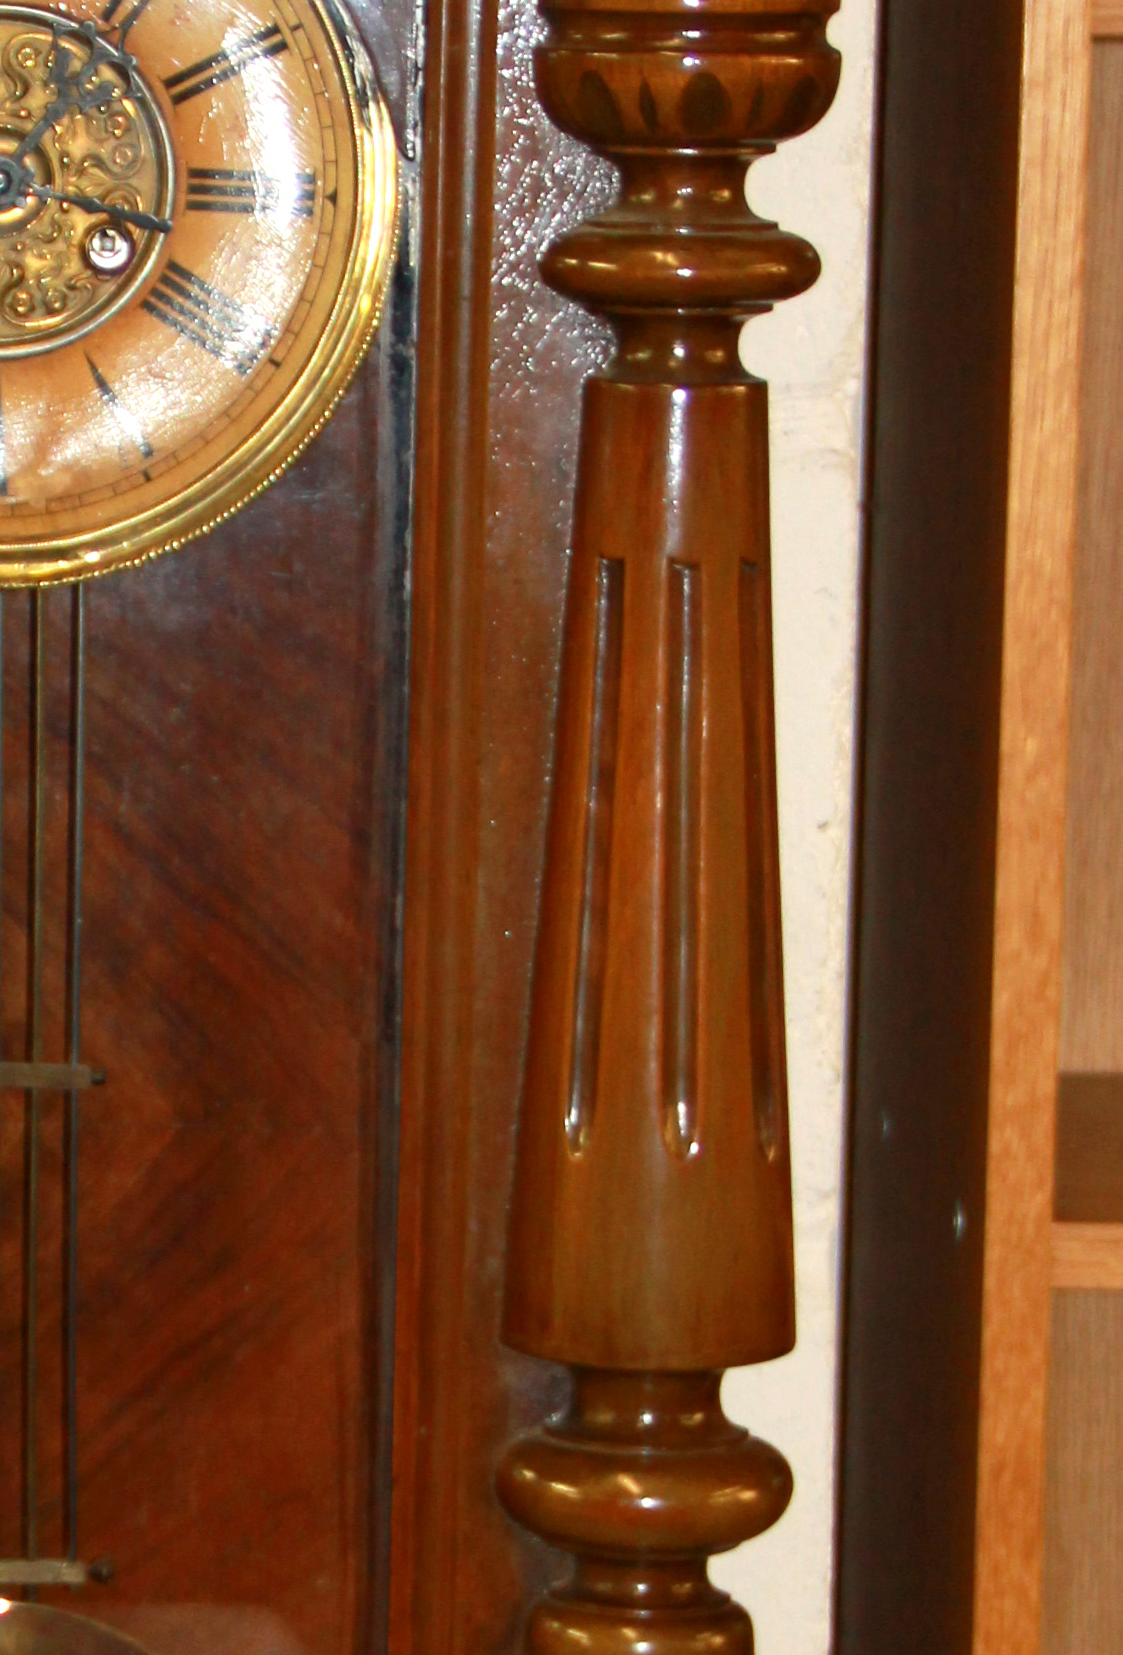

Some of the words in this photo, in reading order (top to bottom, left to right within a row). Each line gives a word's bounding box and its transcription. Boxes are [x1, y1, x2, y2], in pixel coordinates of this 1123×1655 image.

[162, 23, 288, 102] II
[187, 167, 314, 215] III
[142, 259, 275, 375] IIII
